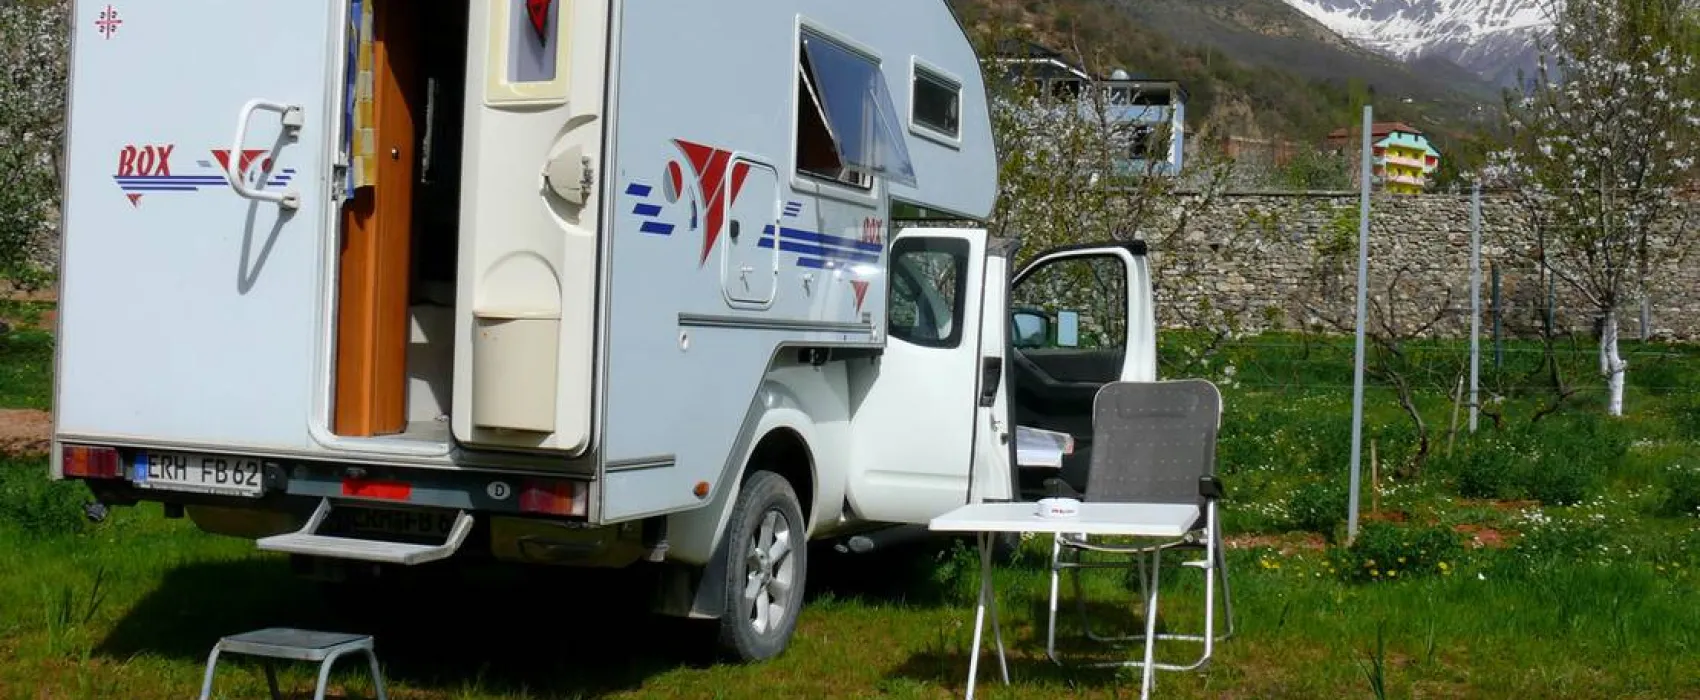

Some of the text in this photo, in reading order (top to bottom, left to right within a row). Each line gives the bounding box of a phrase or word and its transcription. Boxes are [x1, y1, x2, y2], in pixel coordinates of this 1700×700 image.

[117, 144, 174, 176] BOX
[147, 454, 258, 486] ERH FB 62
[494, 483, 505, 496] D
